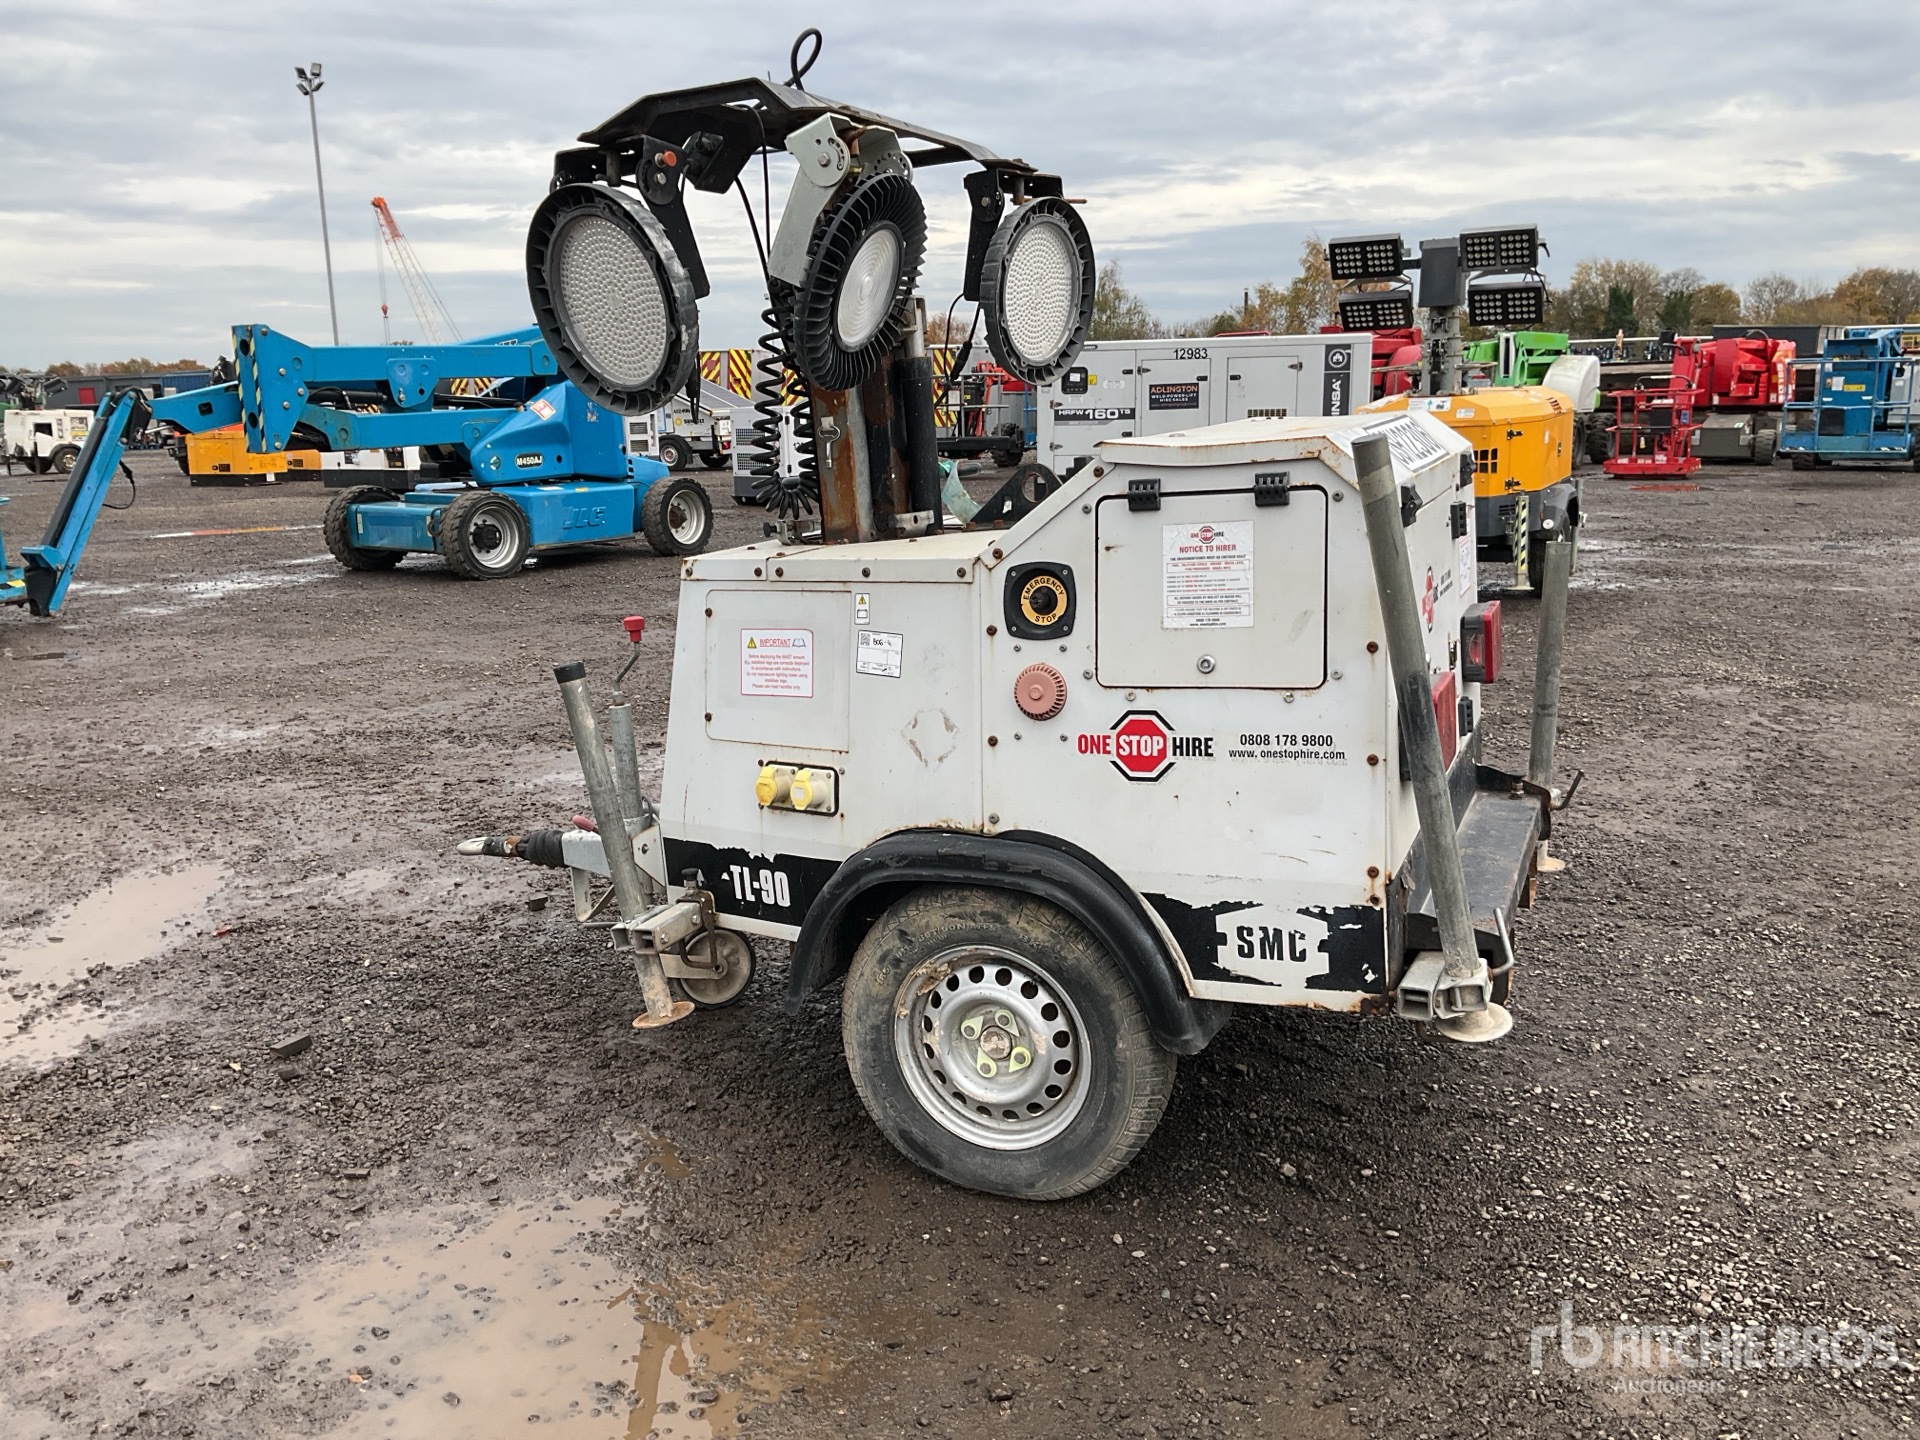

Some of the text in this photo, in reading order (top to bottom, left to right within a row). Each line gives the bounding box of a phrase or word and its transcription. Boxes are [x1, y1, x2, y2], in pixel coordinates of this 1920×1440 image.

[1173, 348, 1208, 360] 12983
[1151, 385, 1198, 393] ADLINGTON
[1331, 379, 1341, 416] INSA
[1085, 409, 1119, 419] 160
[516, 455, 543, 466] M450AJ
[563, 506, 606, 530] JLG
[1179, 545, 1203, 554] NOTICE
[1215, 544, 1237, 552] HIRER
[1023, 577, 1065, 600] EMERGENCY
[1034, 613, 1057, 623] STOP
[759, 638, 791, 647] IMPORTANT
[1078, 734, 1214, 758] ONE STOP HIRE
[1240, 734, 1334, 747] 0808 178 9800
[1228, 748, 1346, 761] www. onestophire.com
[729, 864, 791, 908] TL-90
[1236, 925, 1307, 962] SMC
